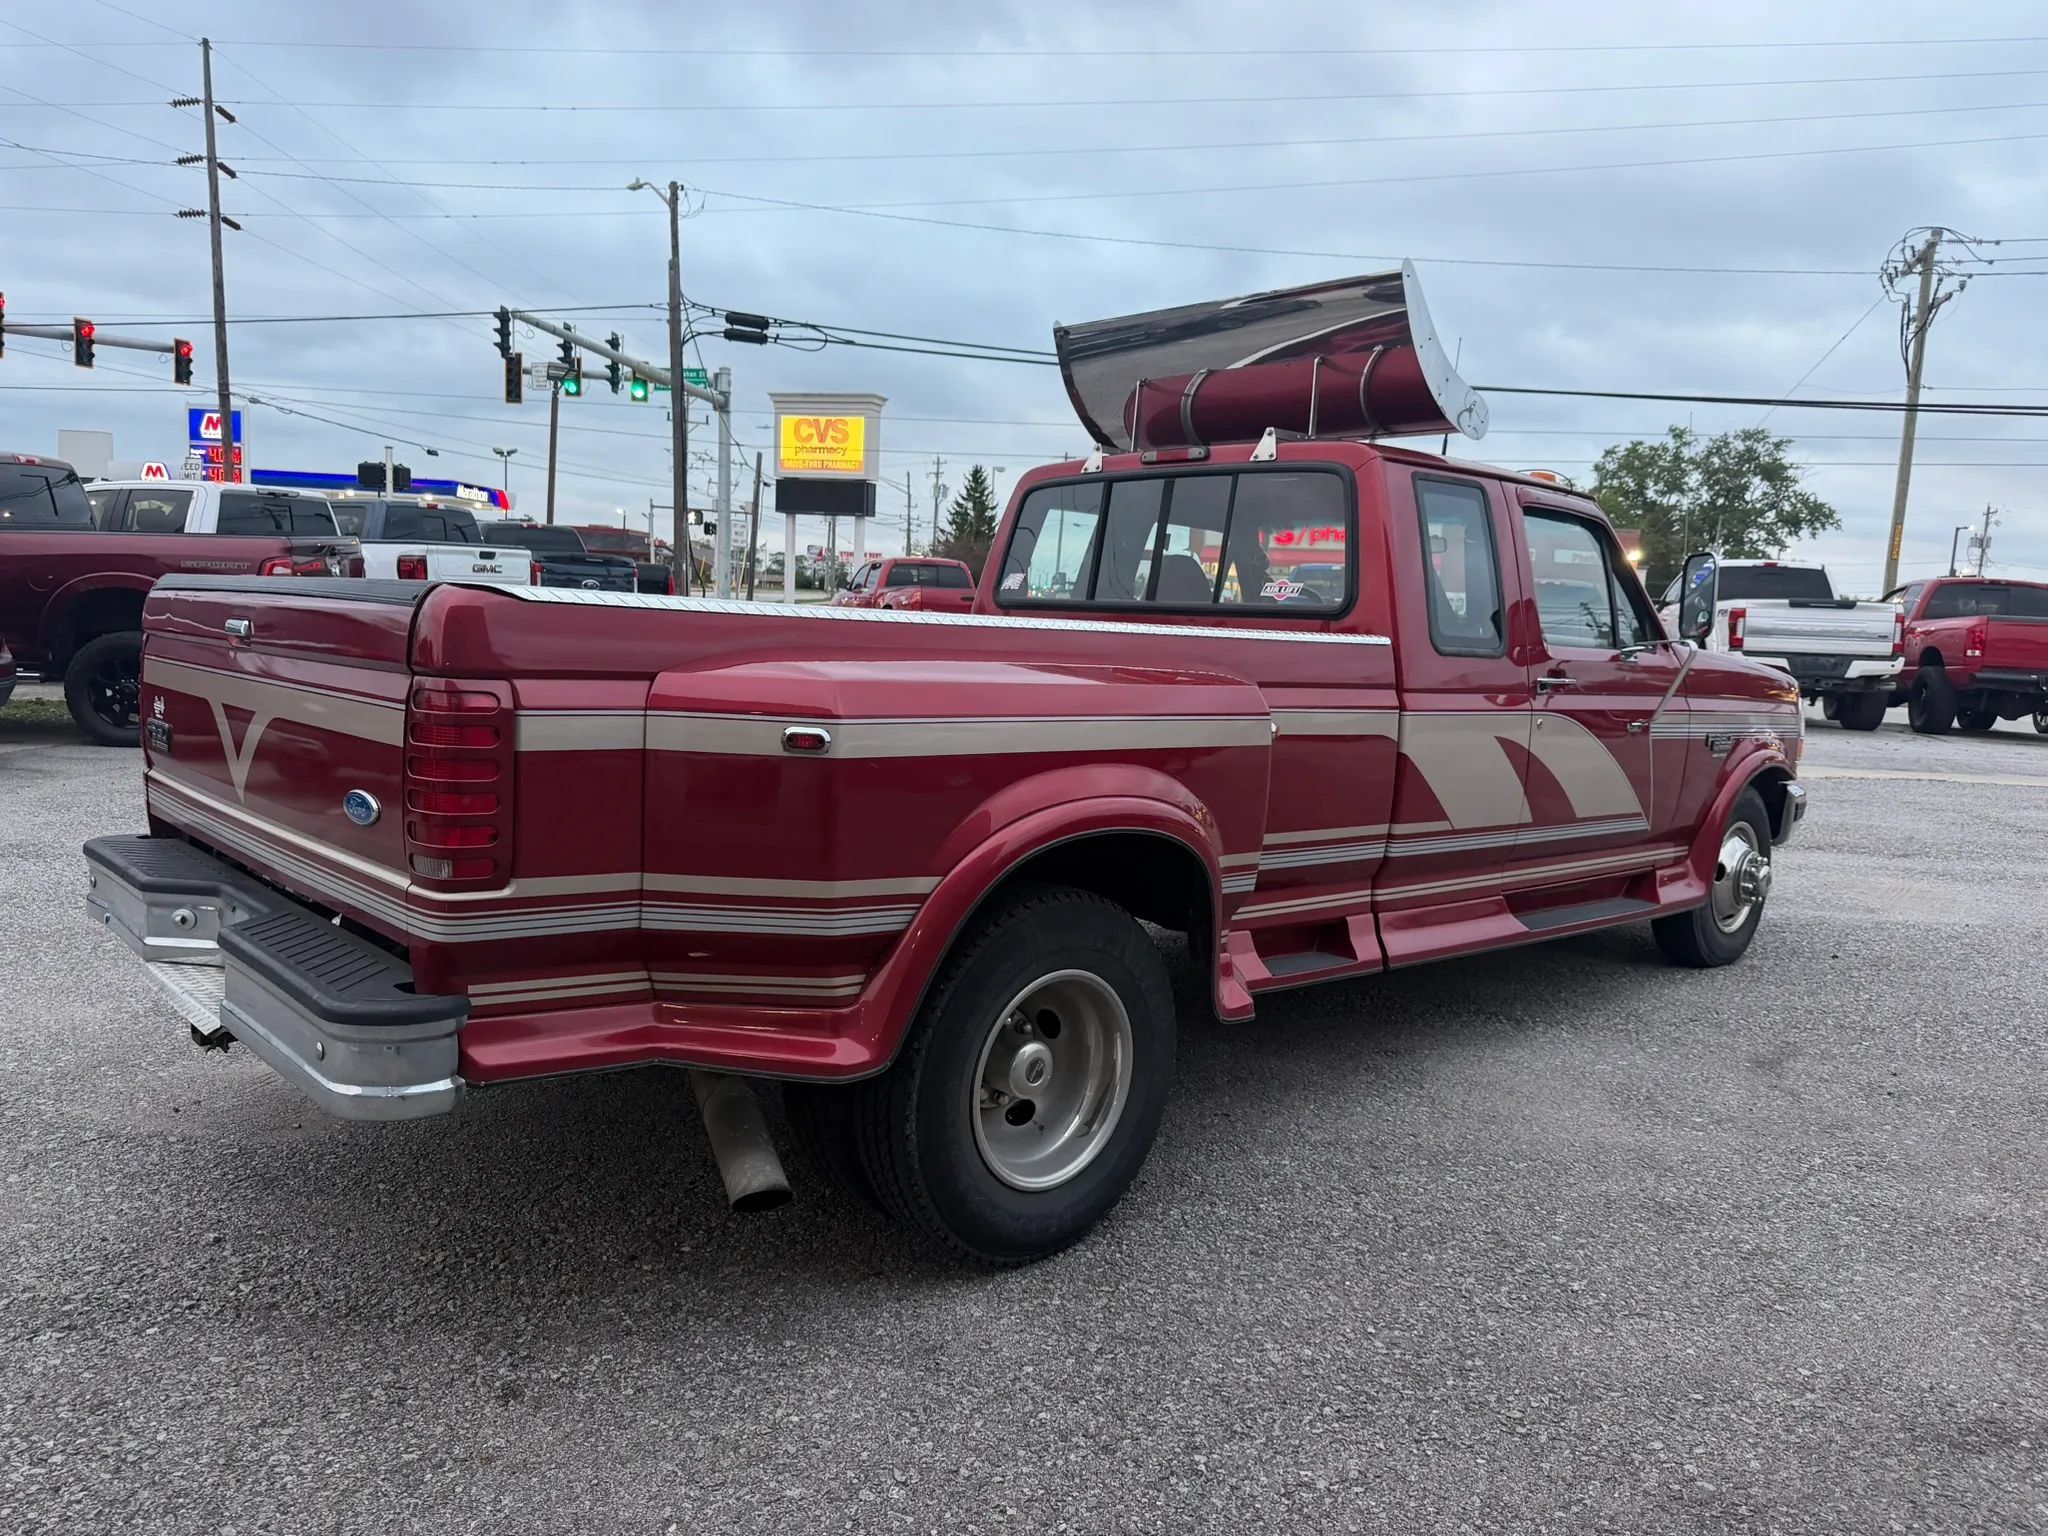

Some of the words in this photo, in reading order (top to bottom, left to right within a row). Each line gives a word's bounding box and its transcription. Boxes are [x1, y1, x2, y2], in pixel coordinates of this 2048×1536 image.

[794, 418, 849, 444] CVS
[794, 445, 848, 457] pharmacy
[145, 465, 164, 478] M
[456, 484, 488, 502] Marathon
[472, 563, 503, 574] GMC
[1264, 585, 1280, 593] AIR
[1280, 585, 1299, 594] LIFT
